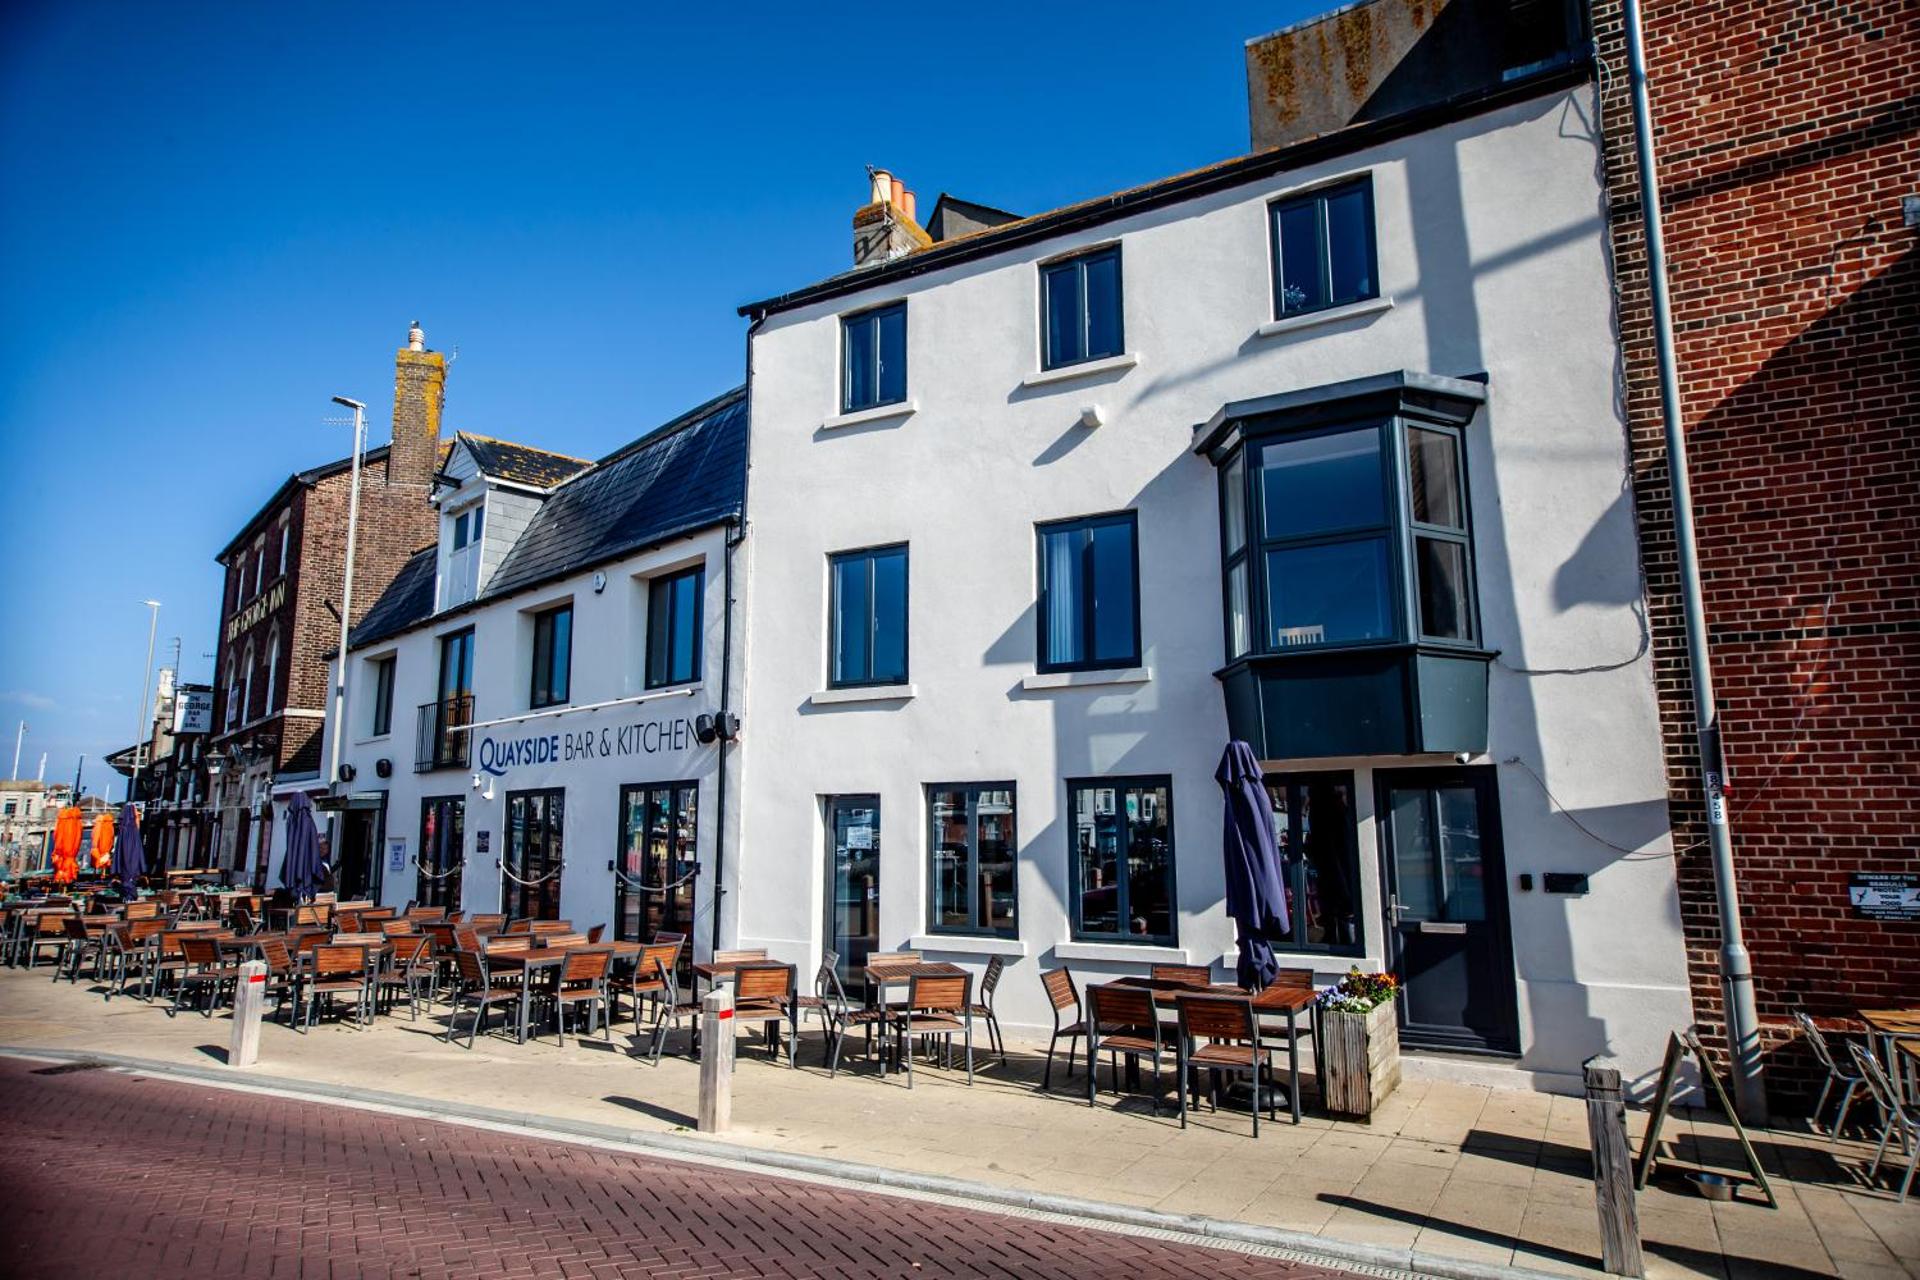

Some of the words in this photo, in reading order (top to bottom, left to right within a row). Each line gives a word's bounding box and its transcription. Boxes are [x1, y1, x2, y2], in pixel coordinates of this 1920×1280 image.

[178, 702, 211, 710] GEORGE
[480, 735, 559, 776] QUAYSIDE
[565, 731, 594, 760] BAR
[600, 728, 611, 757] &
[617, 719, 700, 755] KITCHEN
